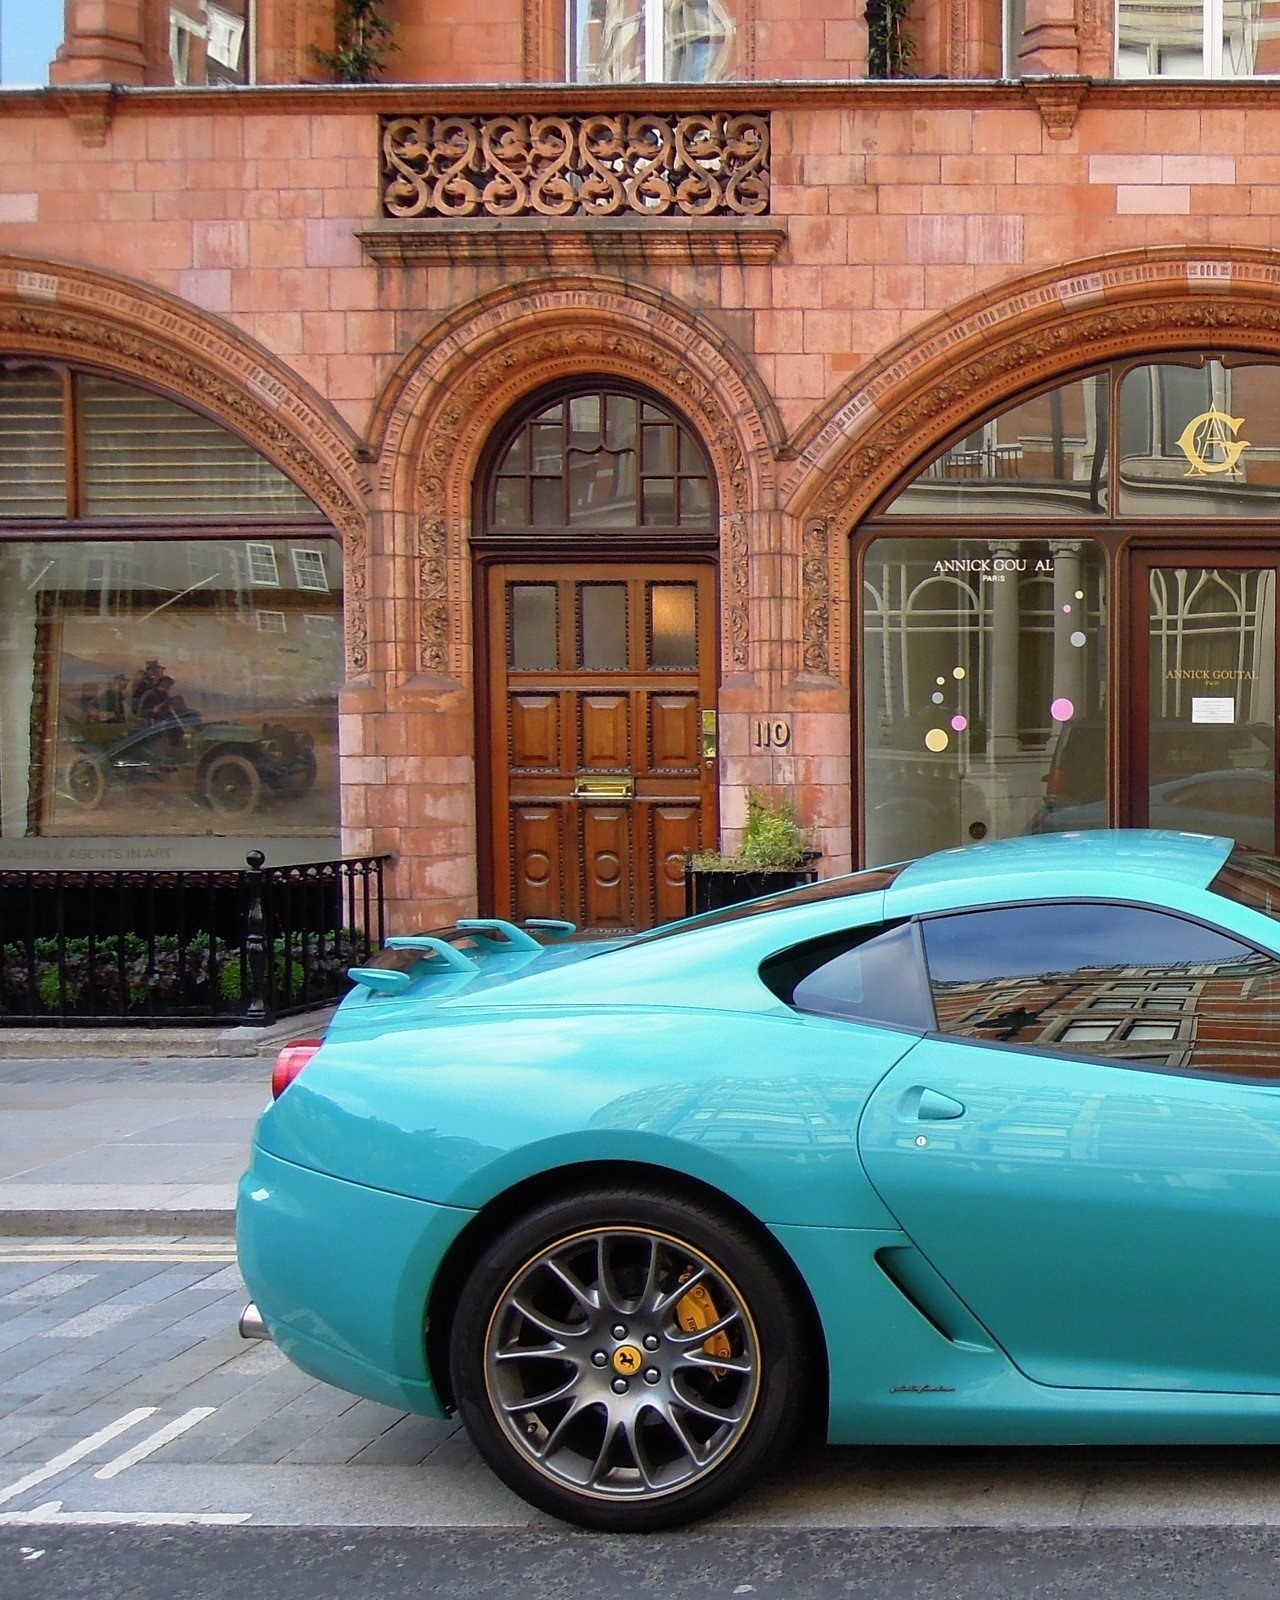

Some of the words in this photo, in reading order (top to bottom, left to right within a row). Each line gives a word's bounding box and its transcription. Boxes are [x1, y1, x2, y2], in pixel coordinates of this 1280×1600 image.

[933, 559, 991, 572] ANNICK
[982, 574, 1006, 583] PARIS
[1166, 669, 1211, 680] ANNICK
[1212, 669, 1260, 681] GOUTAL
[753, 720, 790, 747] 110
